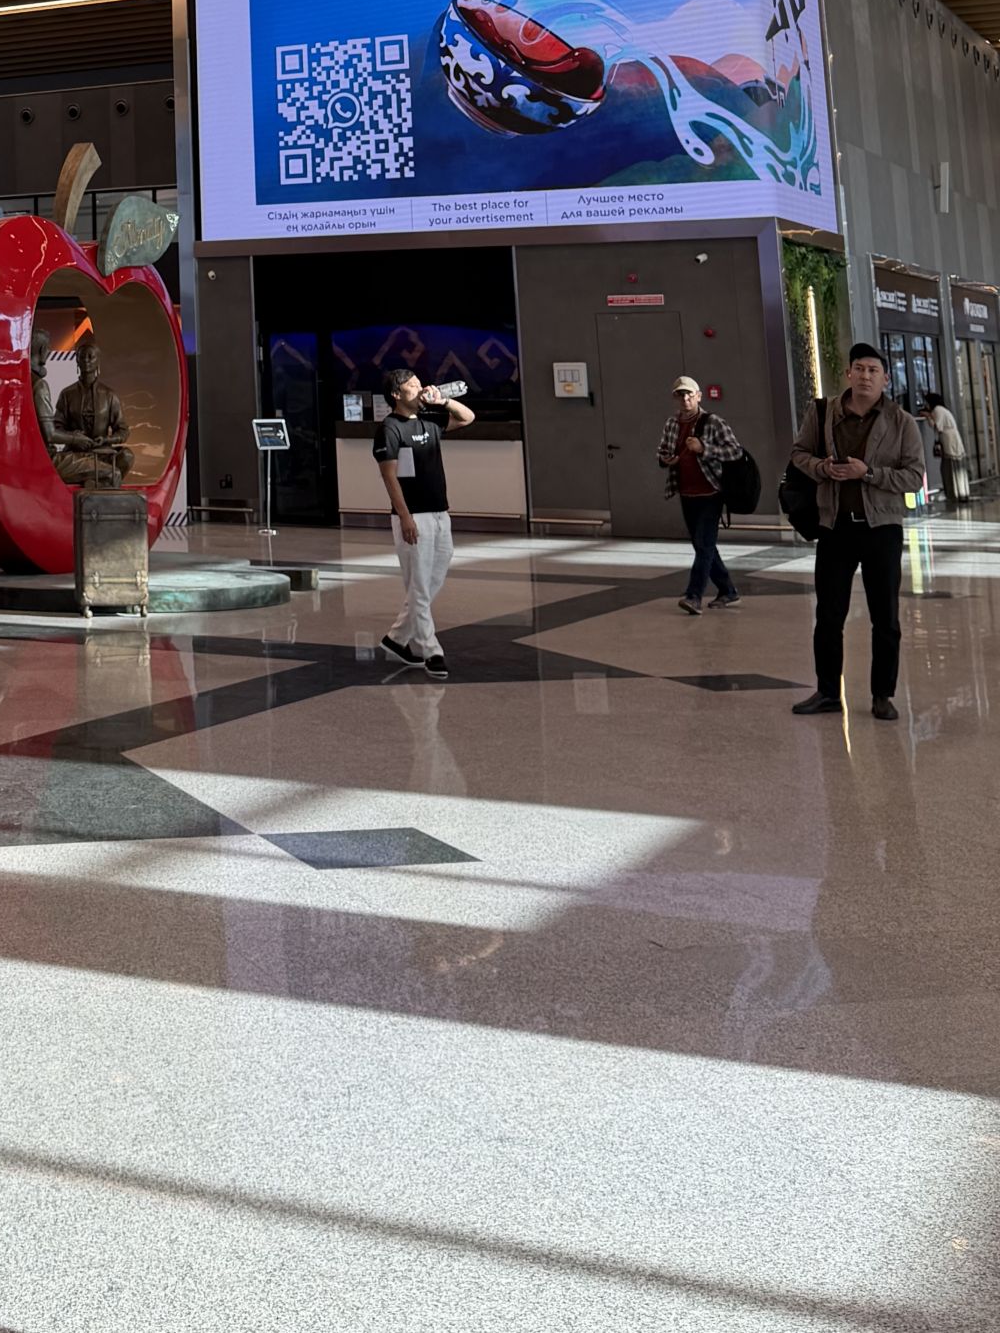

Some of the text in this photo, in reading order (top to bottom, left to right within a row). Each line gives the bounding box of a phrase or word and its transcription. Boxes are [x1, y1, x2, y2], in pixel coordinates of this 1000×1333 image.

[432, 198, 529, 212] The best place for
[577, 192, 664, 205] Лучшее место
[267, 206, 395, 221] Сіздің жарнамаңыз үшін
[428, 212, 534, 227] your advertisement
[561, 205, 683, 220] для вашей рекламы
[286, 221, 377, 233] ең қолайлы орын
